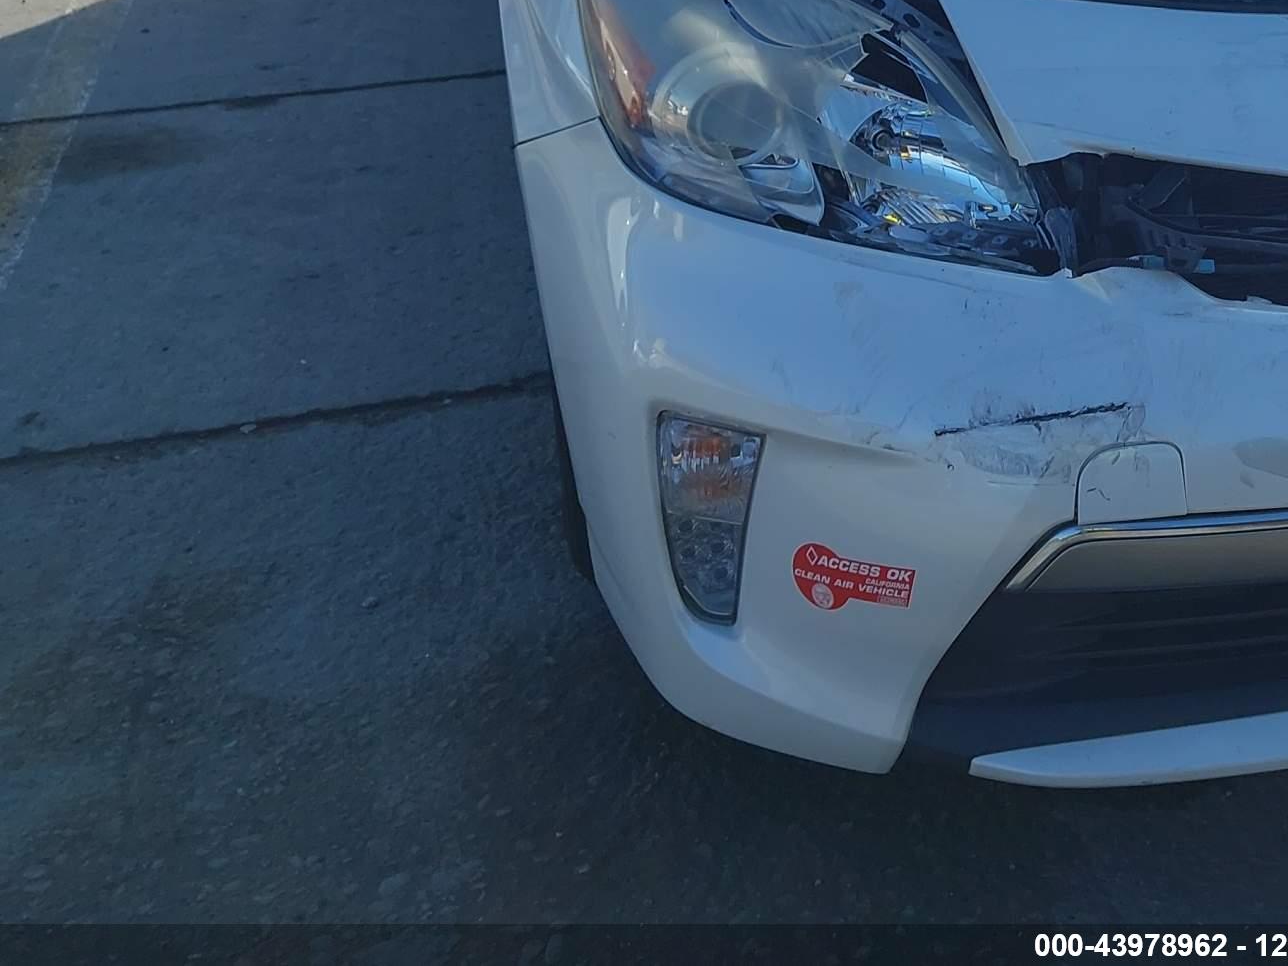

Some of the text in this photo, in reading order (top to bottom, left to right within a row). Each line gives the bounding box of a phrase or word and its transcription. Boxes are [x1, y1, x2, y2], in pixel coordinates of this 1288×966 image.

[817, 555, 913, 582] ACCESS OK
[794, 568, 909, 598] CLEAN AIR VEHICLE
[865, 578, 910, 590] CALIFORNIA
